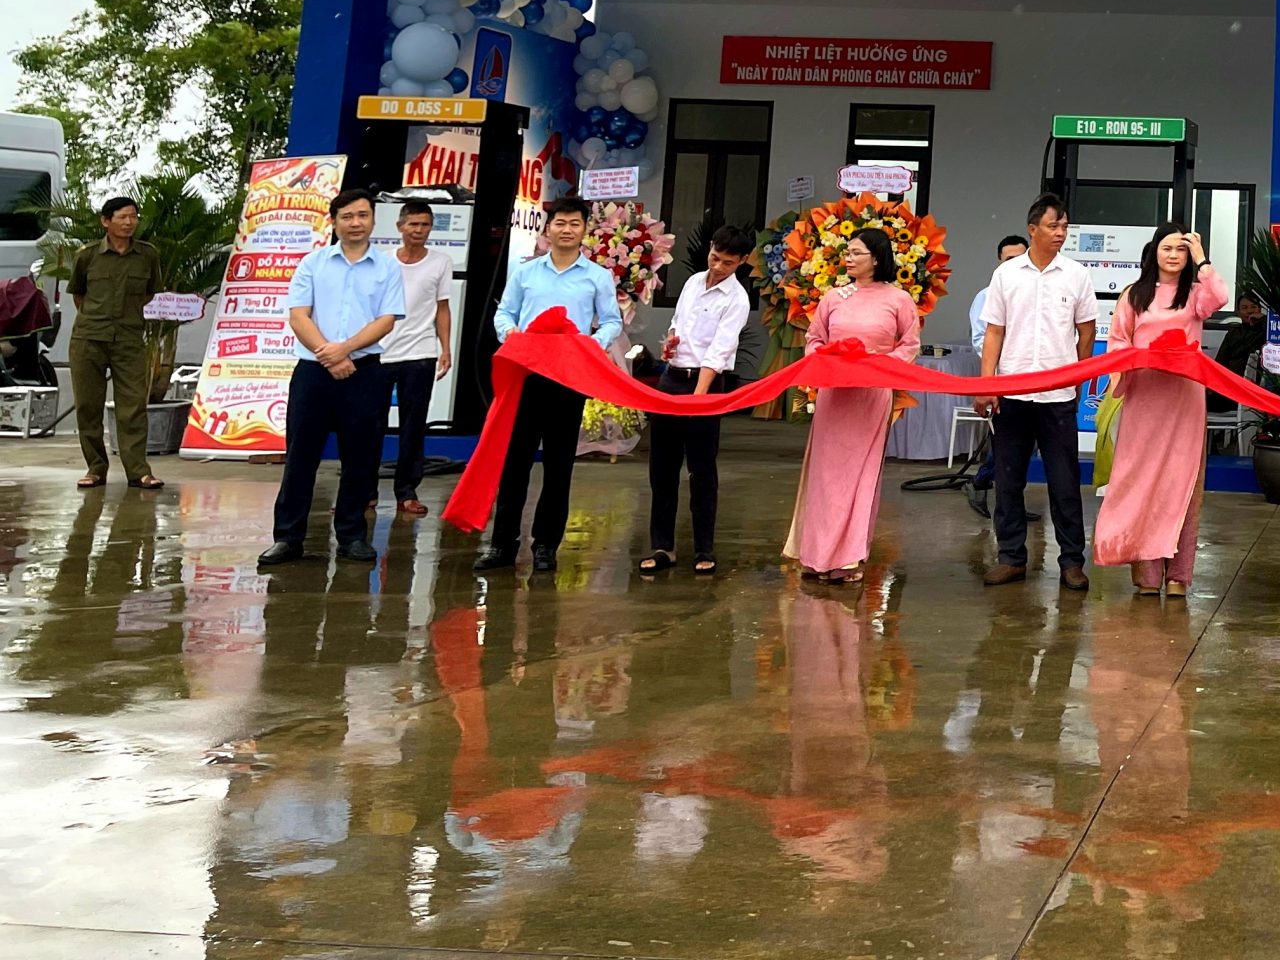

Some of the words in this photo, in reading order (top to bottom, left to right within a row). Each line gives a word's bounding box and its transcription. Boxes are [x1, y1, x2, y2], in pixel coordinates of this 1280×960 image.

[765, 43, 810, 63] NHIỆT
[814, 43, 843, 64] LIỆT
[847, 43, 907, 62] HƯỞNG
[912, 44, 948, 63] ỨNG
[731, 62, 768, 81] "NGÀY
[771, 64, 801, 81] TOÀN
[805, 65, 829, 82] DÂN
[832, 65, 872, 83] PHÒNG
[875, 67, 906, 84] CHÁY
[909, 67, 940, 85] CHỮA
[943, 68, 981, 86] CHÁY"
[381, 101, 398, 114] DO
[405, 101, 441, 116] 0,05S
[454, 102, 463, 115] II
[1076, 120, 1096, 134] E10
[1106, 121, 1128, 135] RON
[1150, 122, 1161, 136] III
[407, 143, 465, 185] KHAI
[247, 195, 281, 214] KHAI
[523, 206, 541, 235] LỘC
[262, 296, 277, 307] 01
